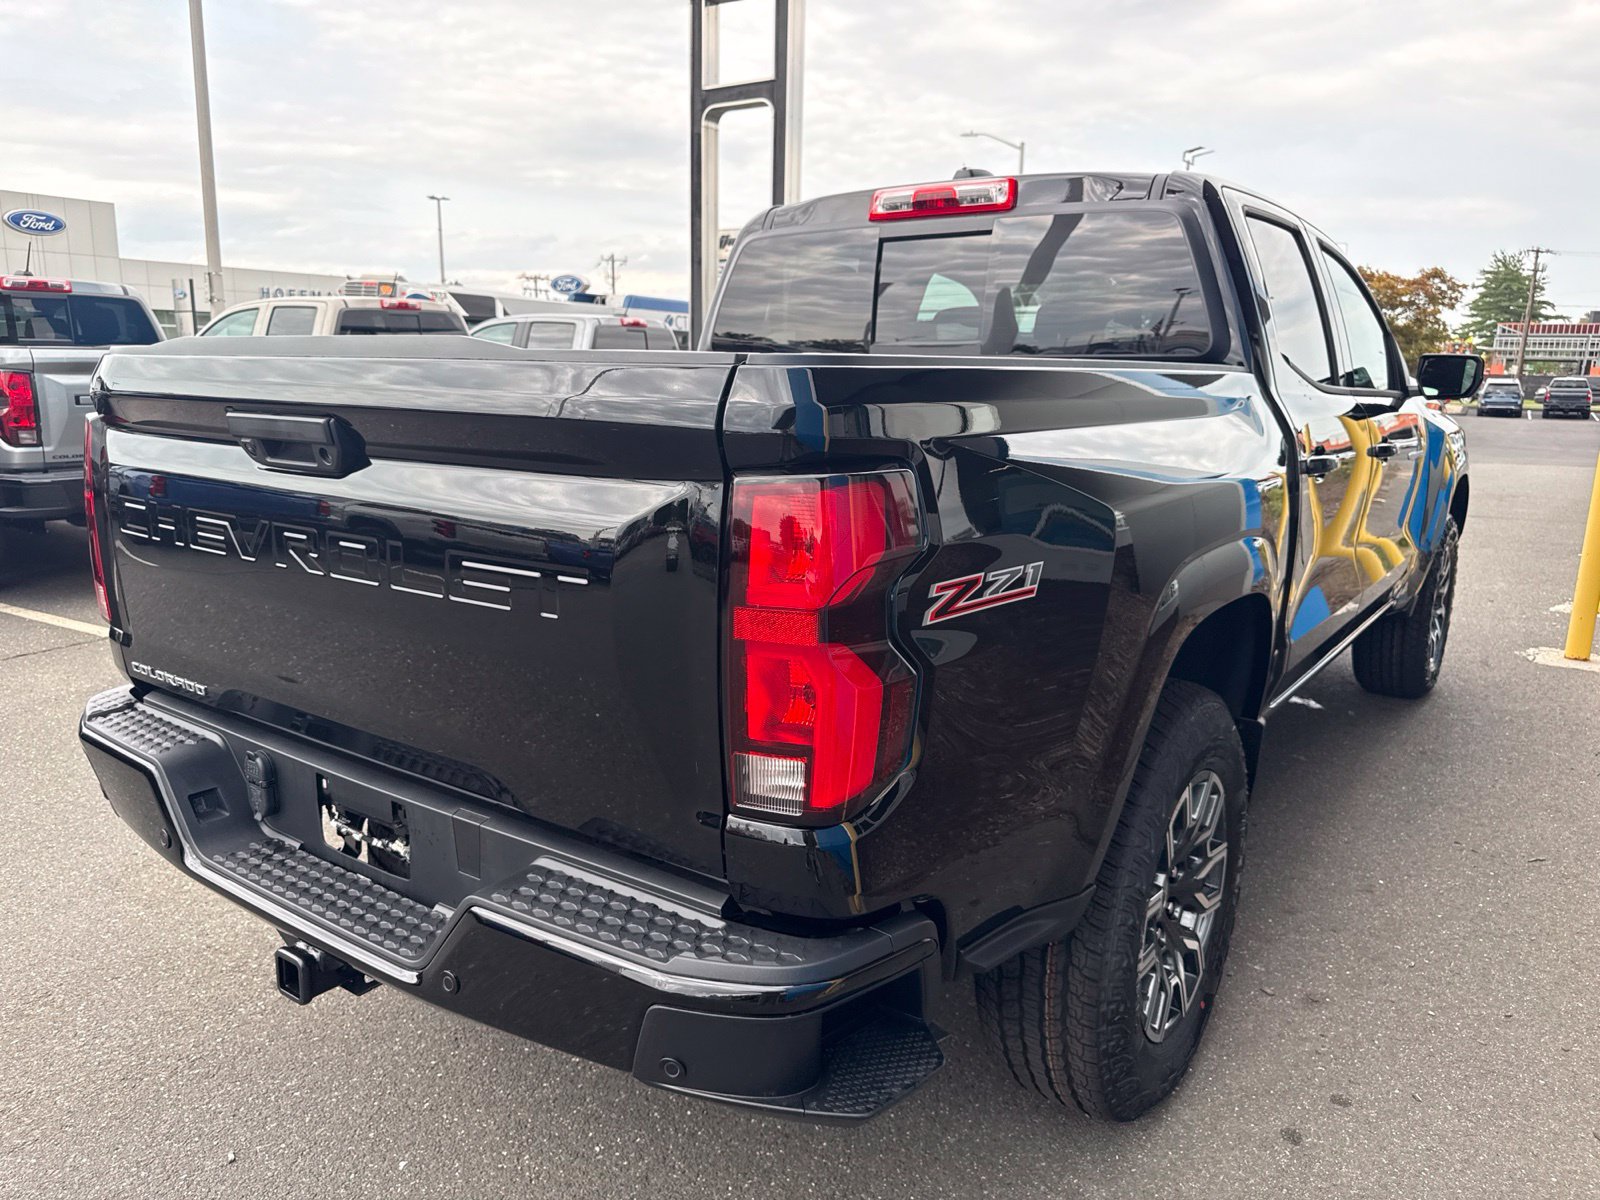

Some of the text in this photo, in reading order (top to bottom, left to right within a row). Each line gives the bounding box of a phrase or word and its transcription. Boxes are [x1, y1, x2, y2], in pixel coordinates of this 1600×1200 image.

[20, 213, 56, 231] Ford
[119, 497, 590, 620] CHEVROLET
[922, 561, 1044, 627] Z71
[131, 661, 208, 696] COLORADO
